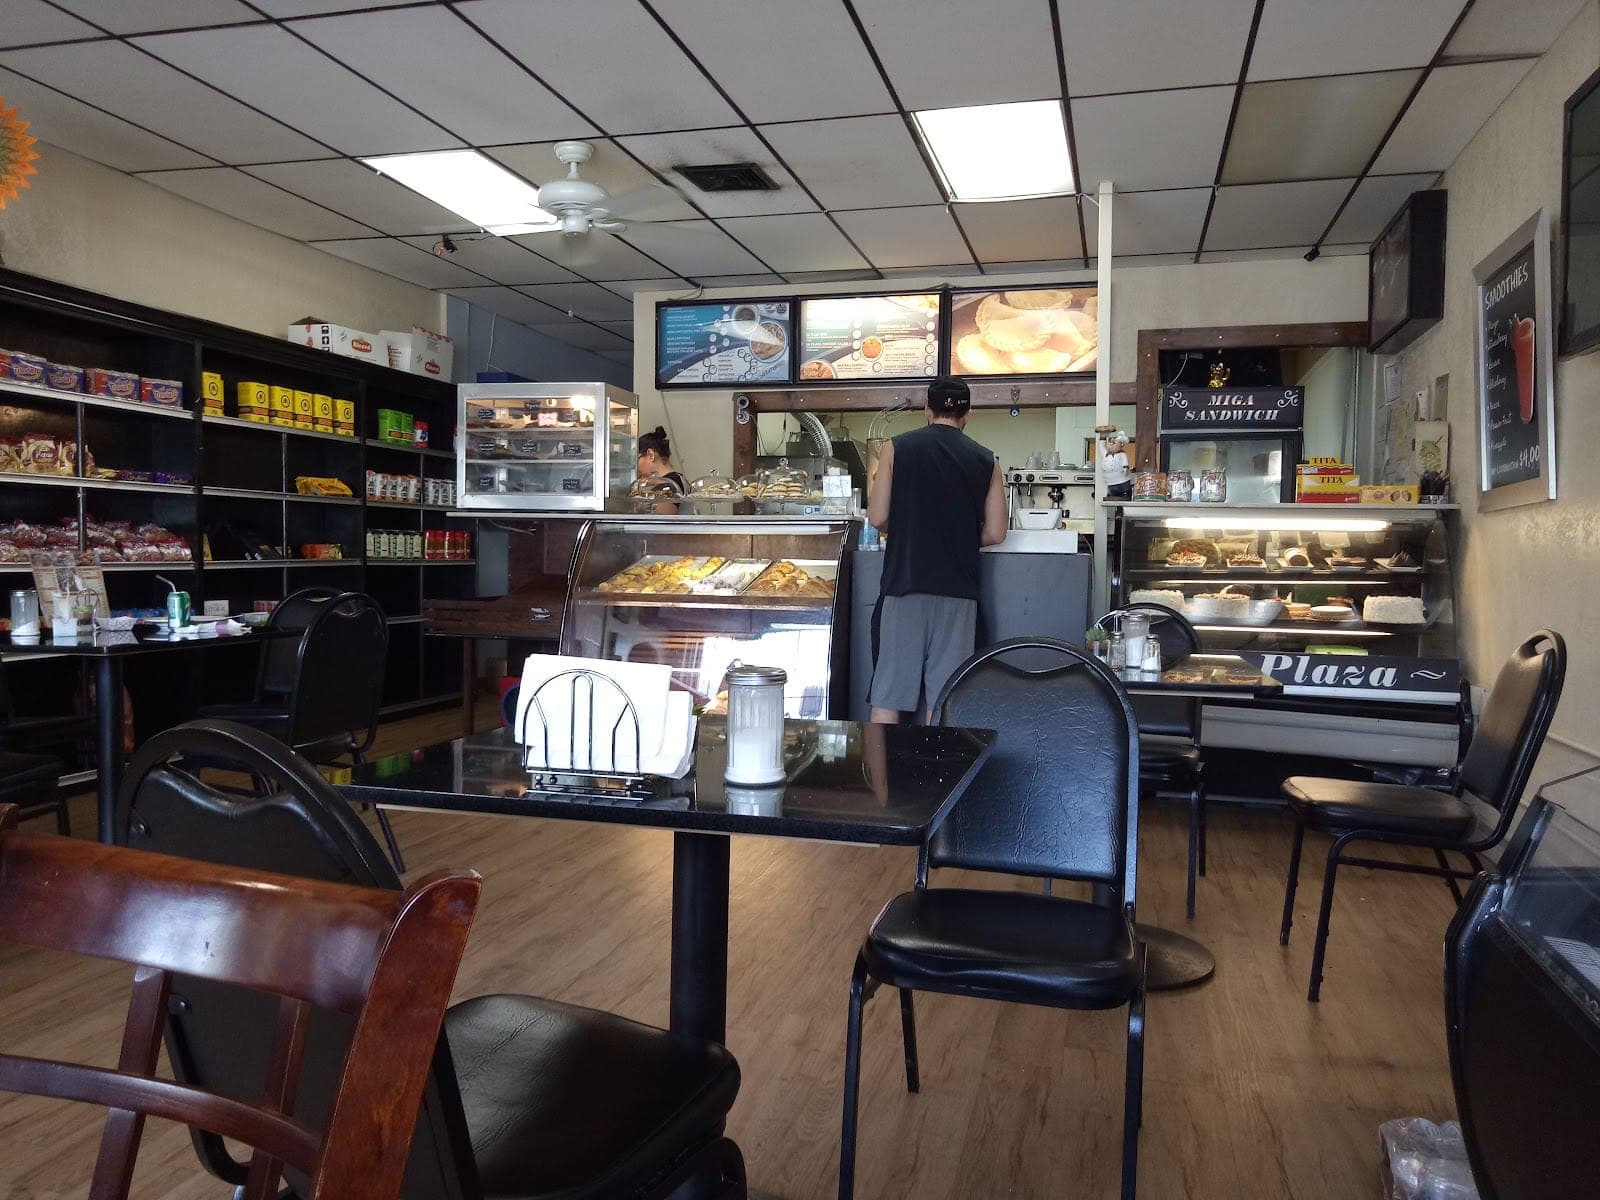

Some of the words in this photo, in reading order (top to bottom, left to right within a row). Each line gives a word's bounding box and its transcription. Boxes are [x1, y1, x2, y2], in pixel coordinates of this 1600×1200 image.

[1485, 262, 1528, 310] SMOOTHIES
[1208, 394, 1254, 406] MIGA
[1184, 409, 1279, 421] SANDWICH
[1320, 476, 1343, 484] TITA
[1261, 653, 1398, 687] Plaza
